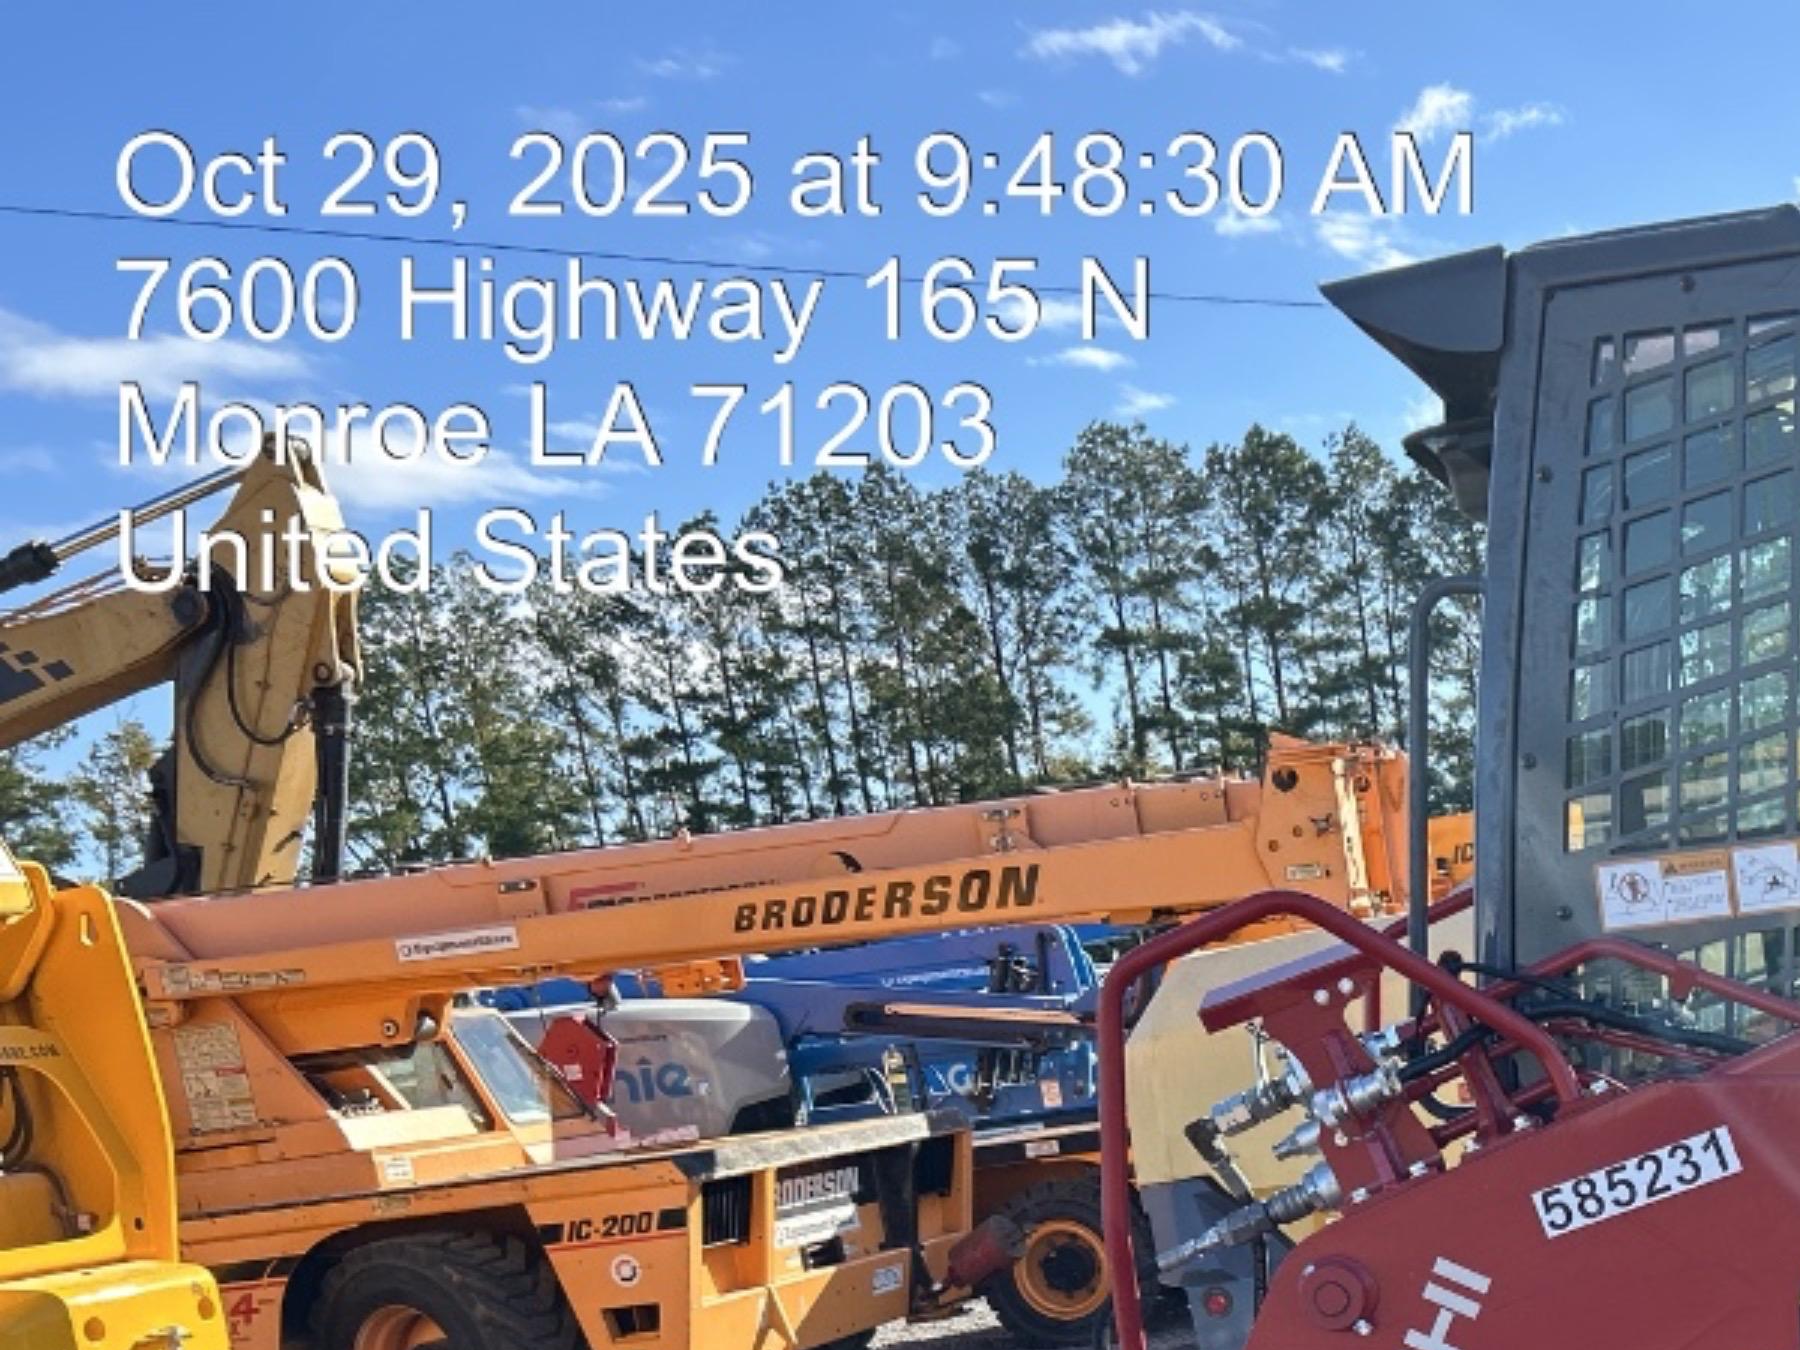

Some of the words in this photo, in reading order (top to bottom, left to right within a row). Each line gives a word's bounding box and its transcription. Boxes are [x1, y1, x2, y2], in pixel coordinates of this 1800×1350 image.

[733, 863, 1041, 934] BRODERSON
[1539, 1129, 1734, 1234] 585231
[567, 1211, 655, 1243] IC-200
